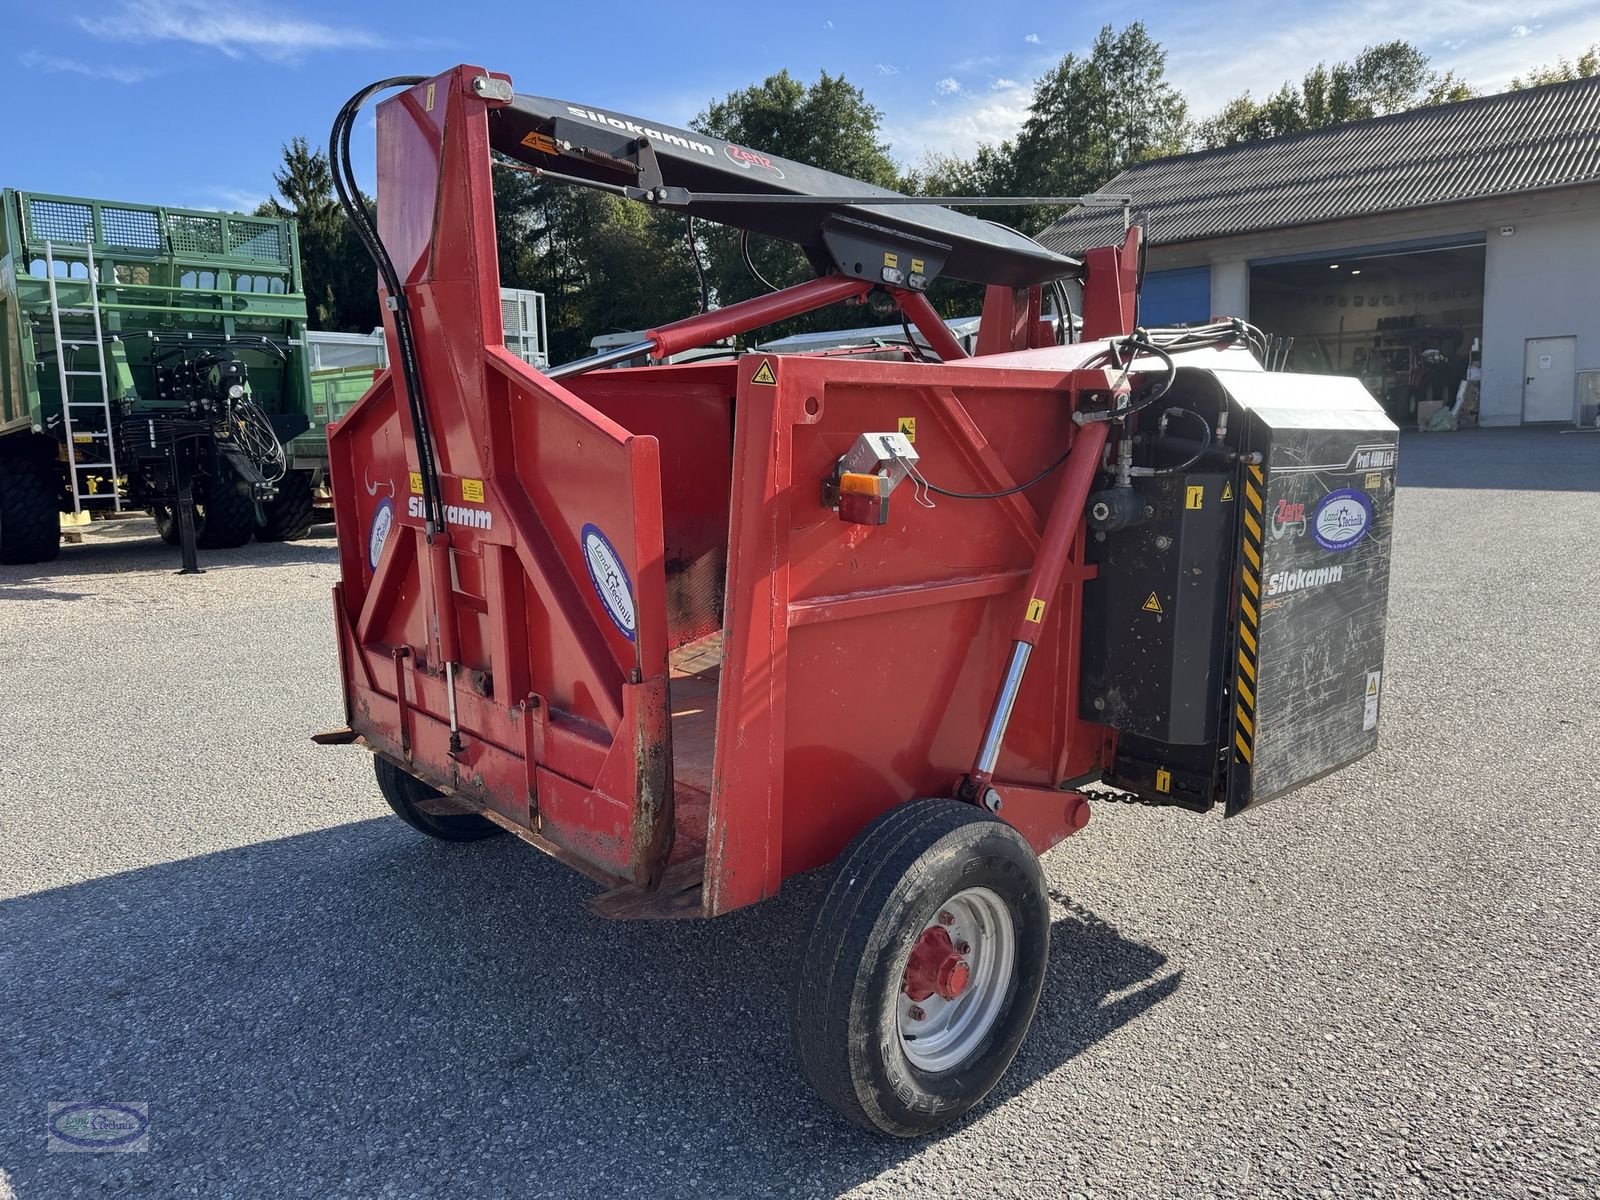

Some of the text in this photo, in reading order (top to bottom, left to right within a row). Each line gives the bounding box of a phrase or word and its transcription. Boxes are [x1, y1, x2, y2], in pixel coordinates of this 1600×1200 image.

[567, 106, 715, 156] Silokamm
[726, 144, 775, 170] Zenz
[1277, 500, 1304, 523] Zenz
[594, 544, 611, 571] Land
[609, 581, 631, 625] Technik
[1267, 565, 1343, 596] Silokamm
